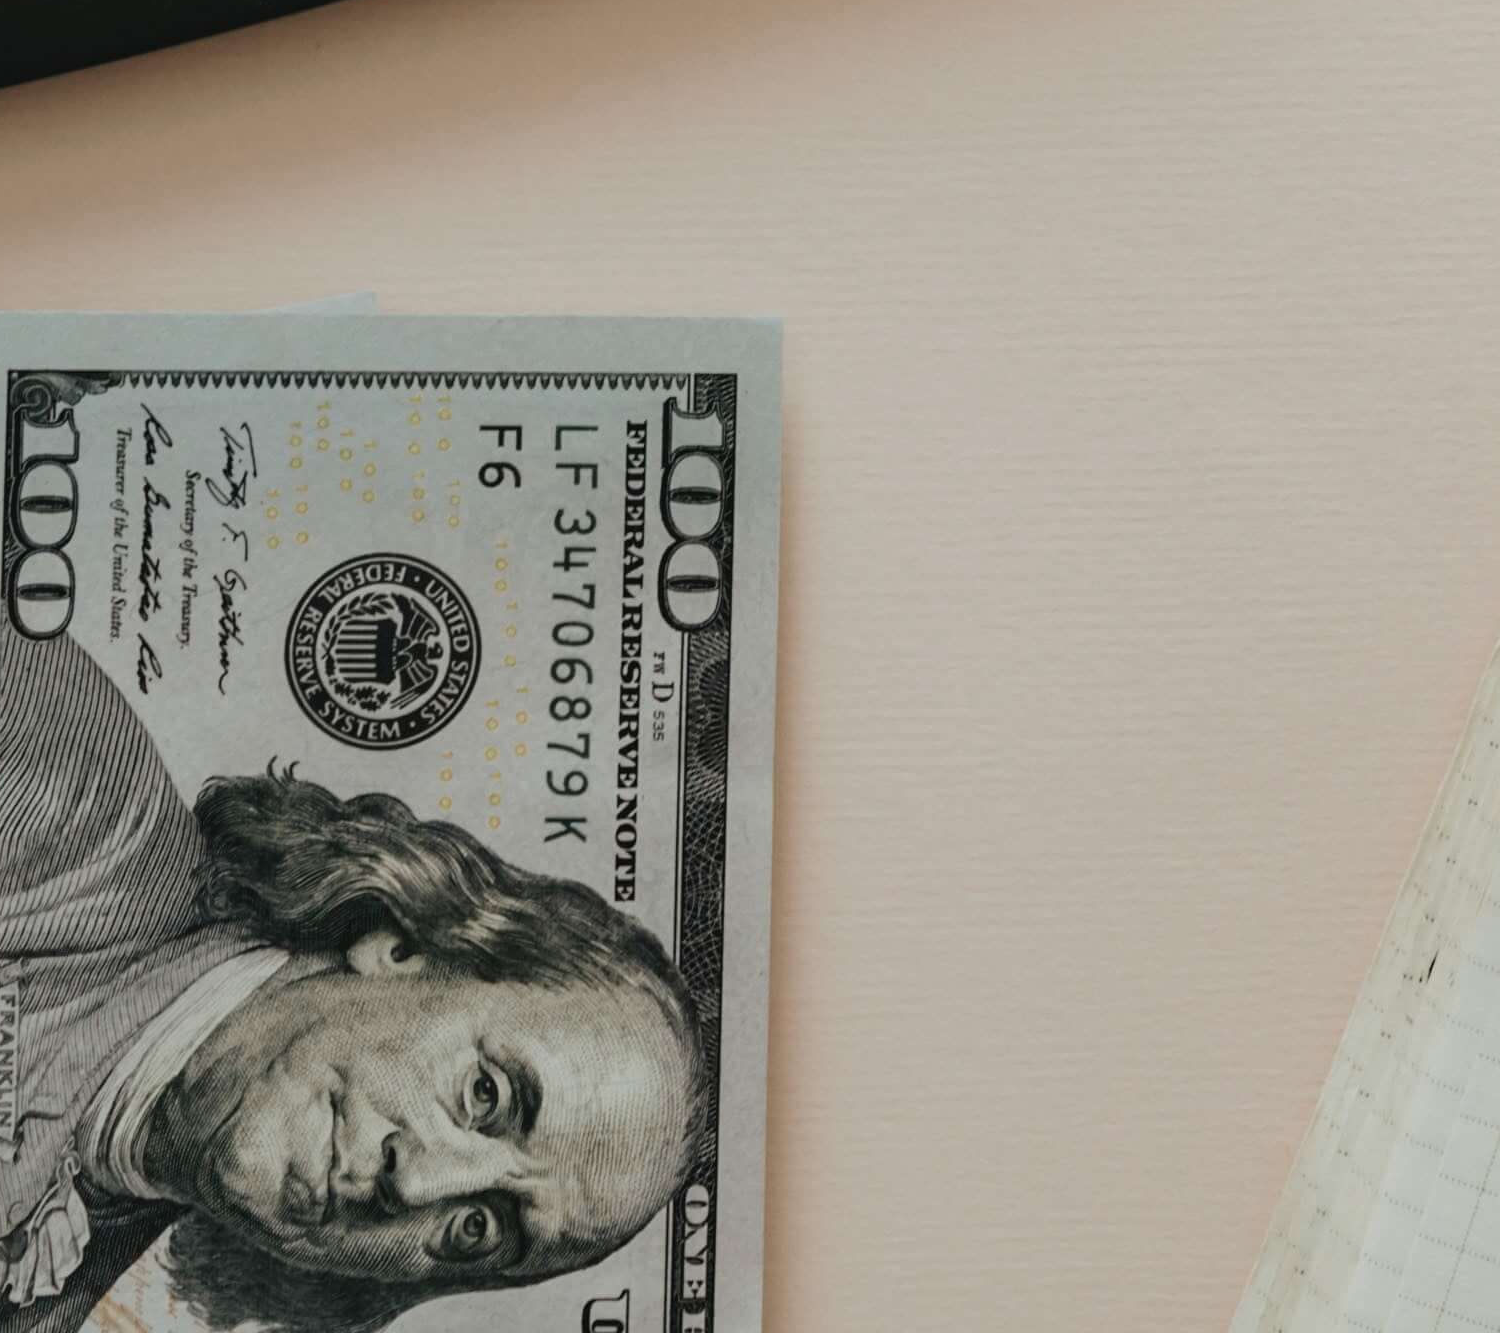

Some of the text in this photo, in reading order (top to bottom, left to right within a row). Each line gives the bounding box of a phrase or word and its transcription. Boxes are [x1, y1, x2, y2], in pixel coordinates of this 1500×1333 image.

[2, 403, 81, 642] 100
[478, 424, 523, 489] F6
[656, 396, 732, 637] 100
[543, 425, 599, 843] LF 34706879 K
[614, 419, 648, 902] FEDERAL RESERVE NOTE
